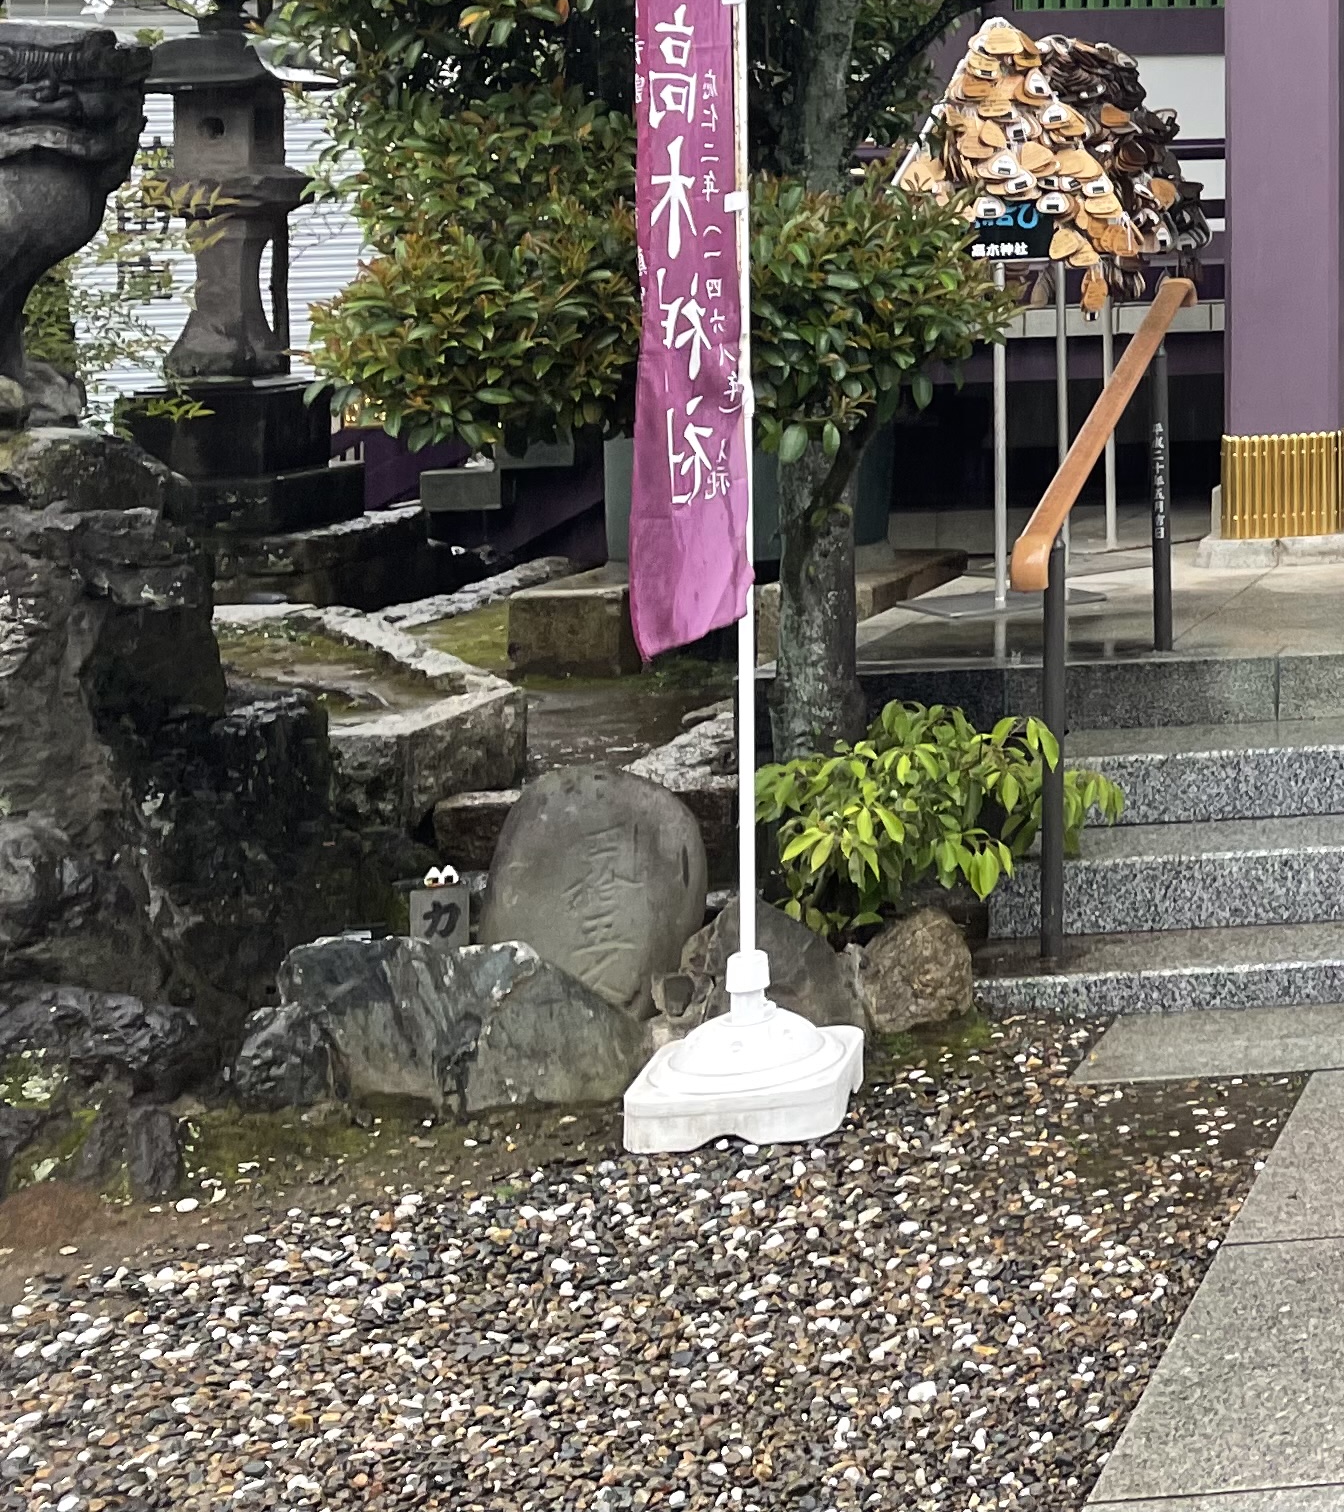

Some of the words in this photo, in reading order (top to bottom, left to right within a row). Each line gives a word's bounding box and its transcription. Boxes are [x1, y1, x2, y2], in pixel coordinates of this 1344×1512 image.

[971, 241, 1029, 257] 高木神社
[422, 900, 462, 939] 力
